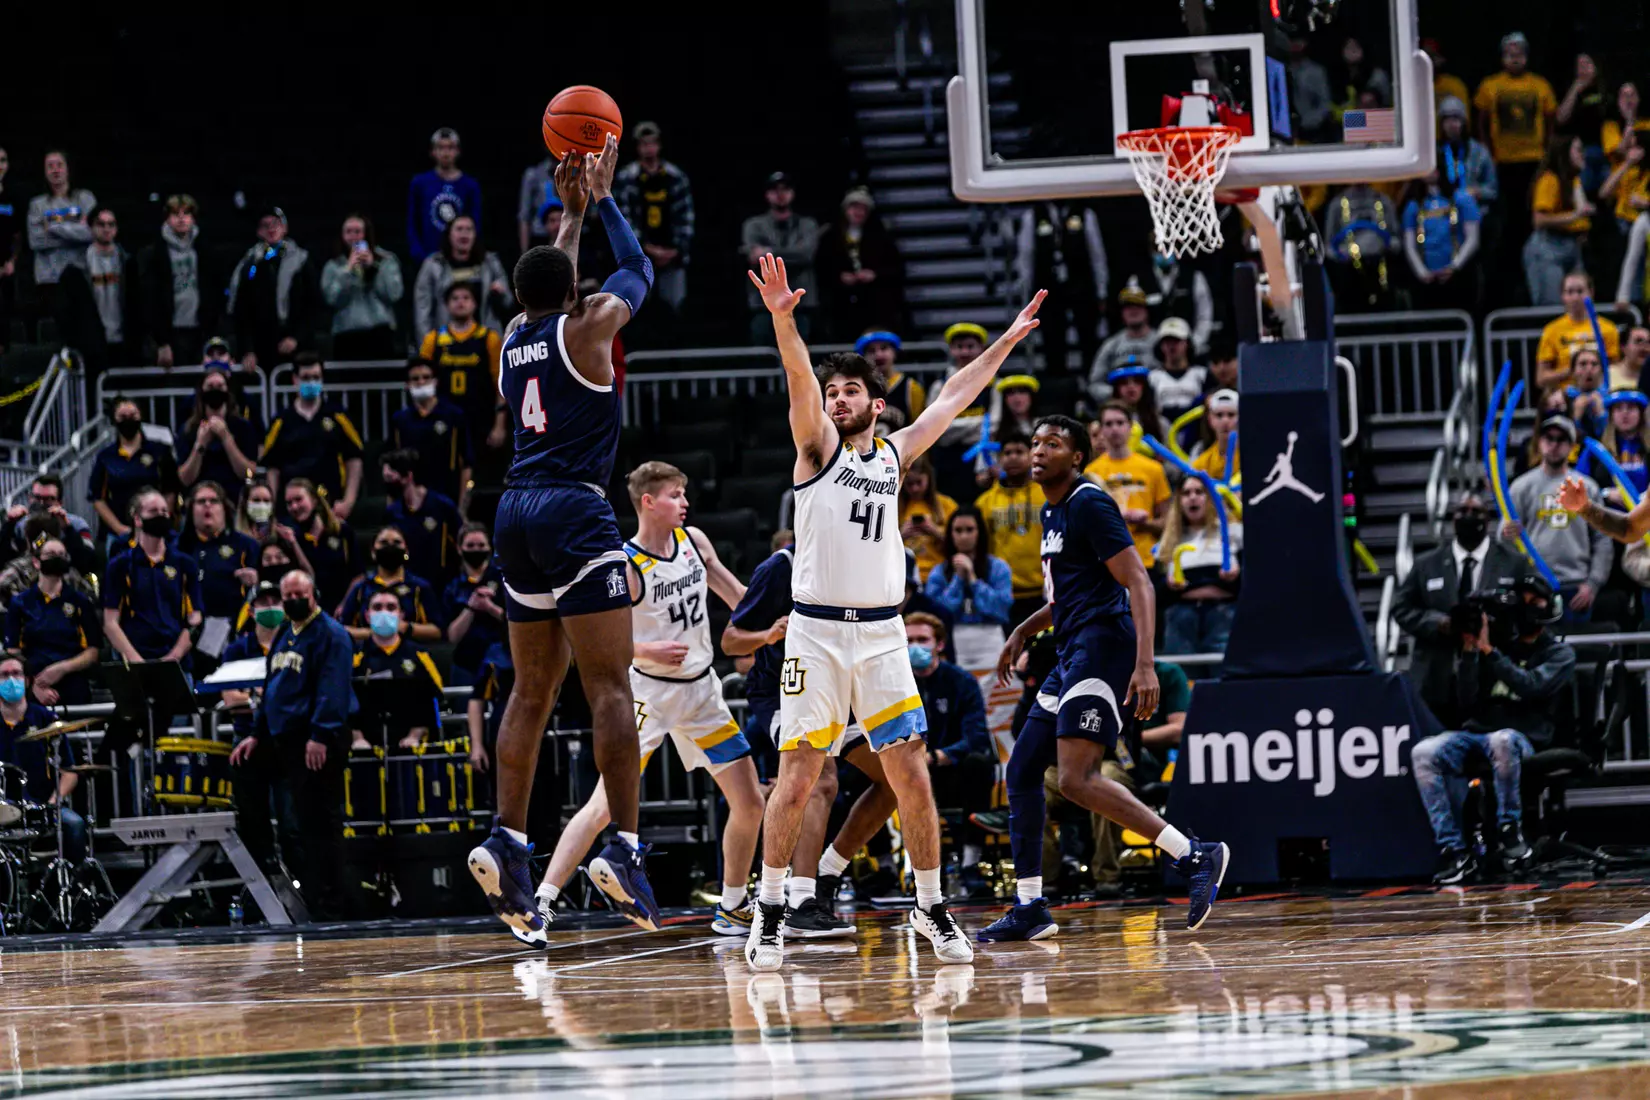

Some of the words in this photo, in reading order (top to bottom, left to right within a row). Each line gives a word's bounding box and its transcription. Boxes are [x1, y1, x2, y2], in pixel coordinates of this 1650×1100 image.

[507, 341, 549, 368] YOUNG
[521, 376, 548, 434] 4
[849, 499, 886, 542] 41
[668, 591, 704, 632] 42
[780, 658, 807, 695] MU
[1188, 708, 1410, 797] meijer
[131, 828, 166, 840] JARVIS
